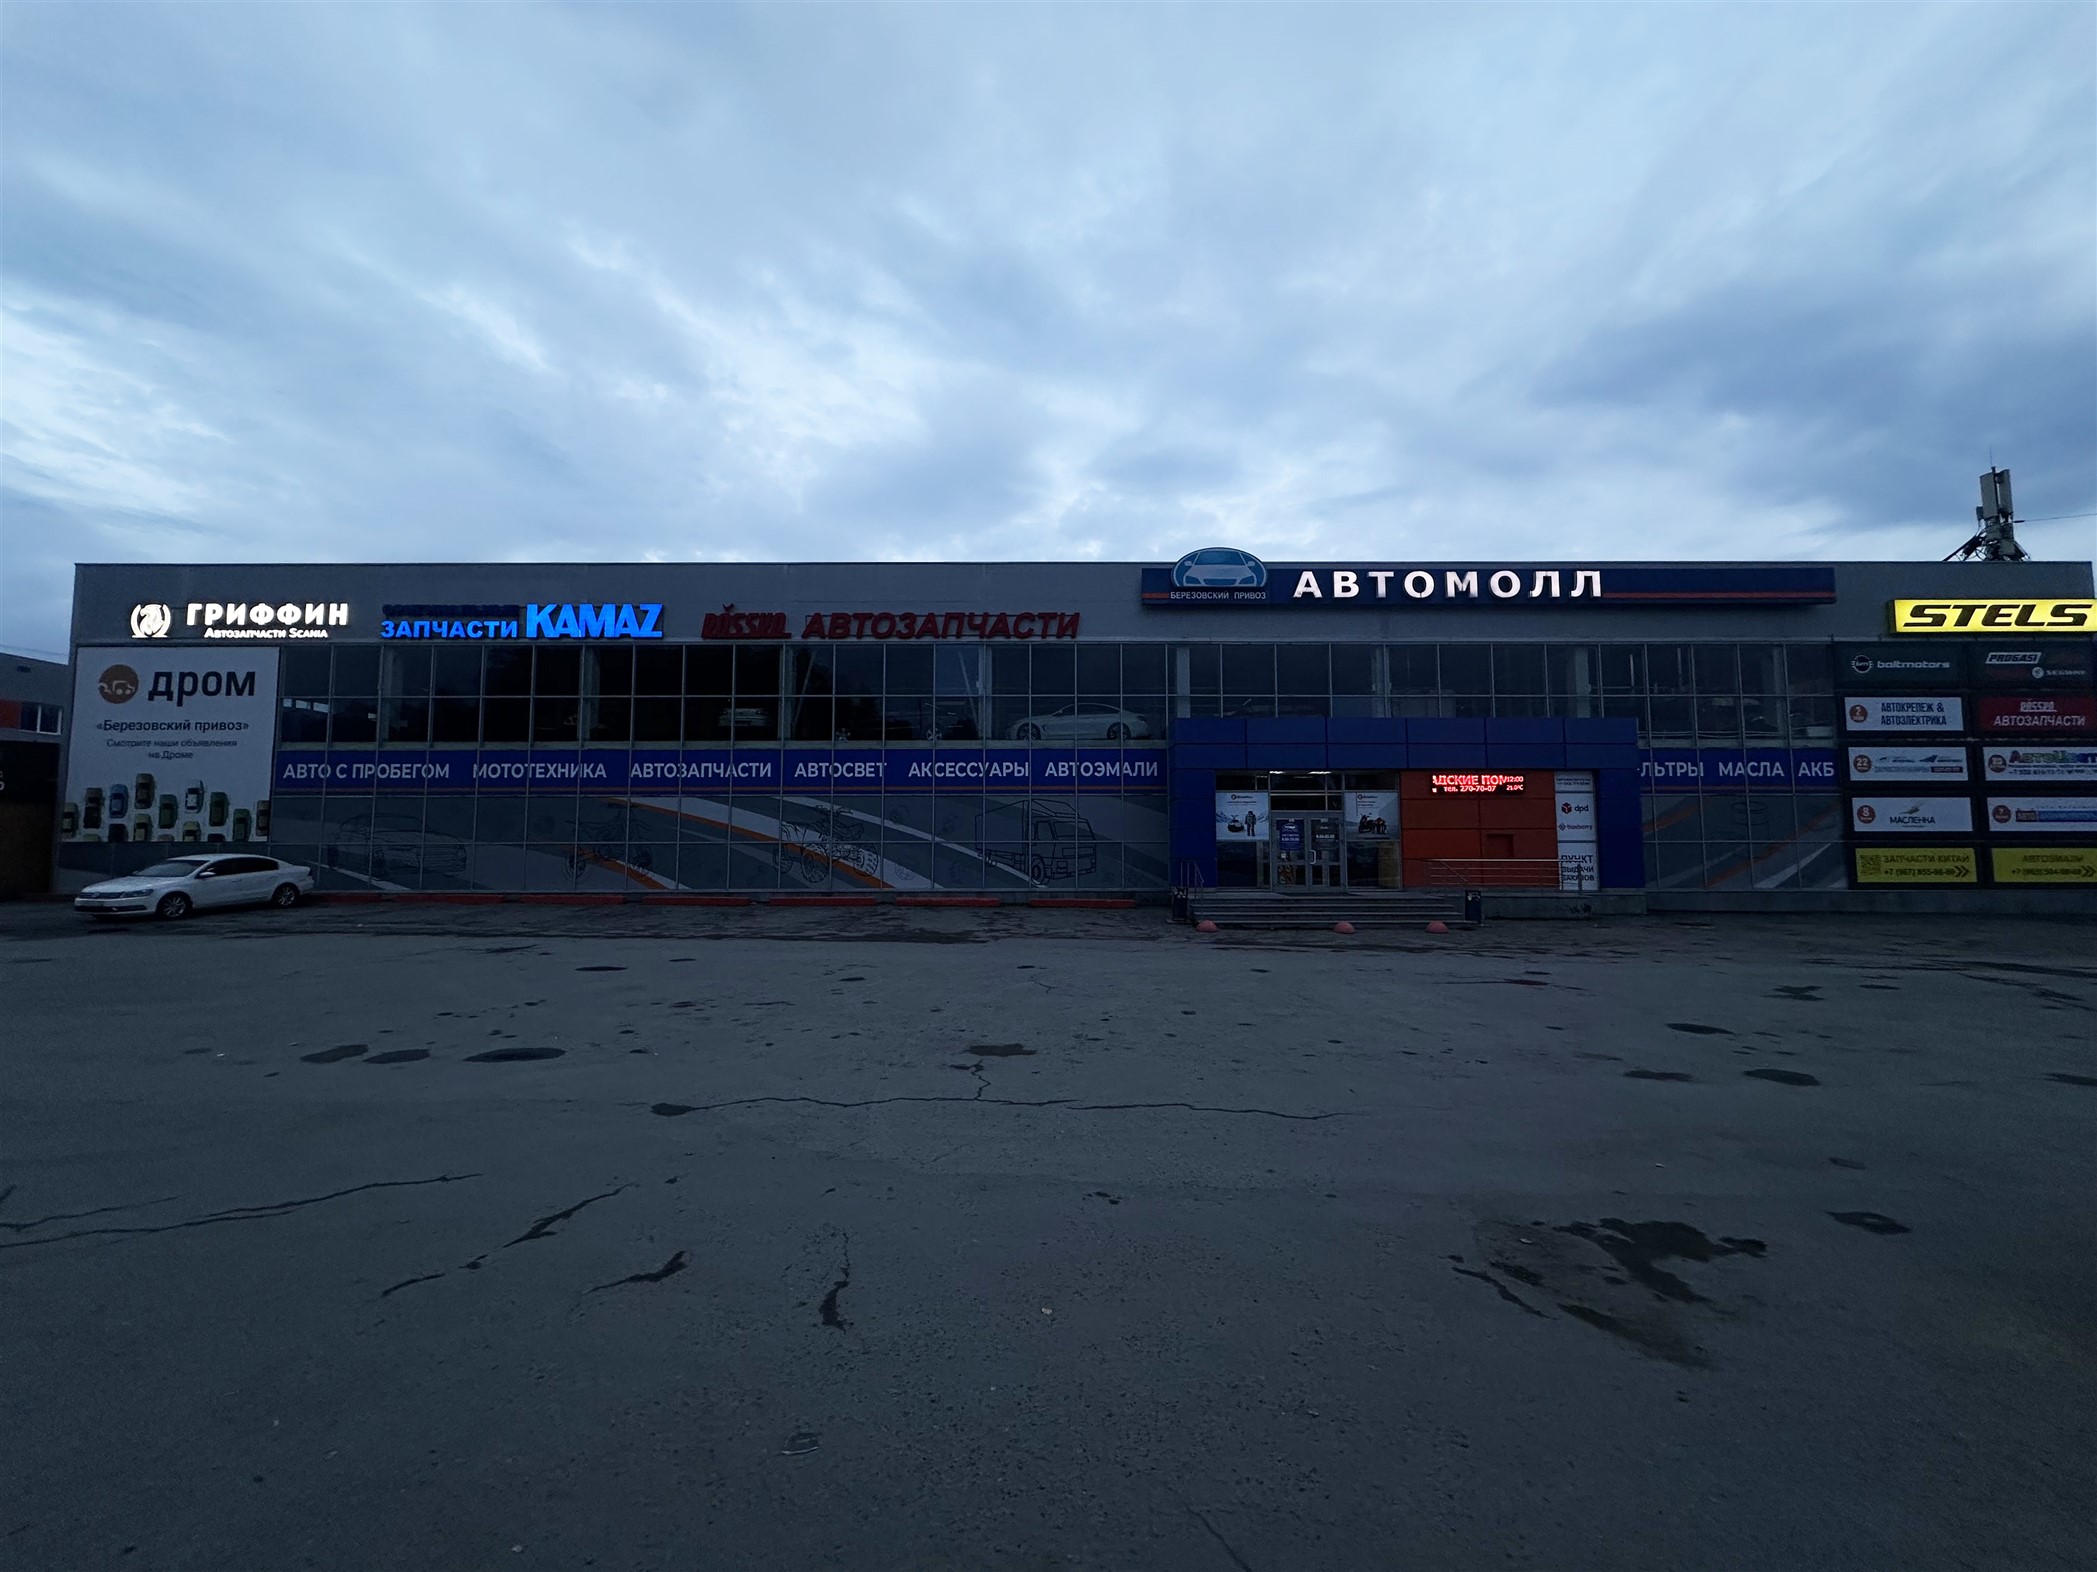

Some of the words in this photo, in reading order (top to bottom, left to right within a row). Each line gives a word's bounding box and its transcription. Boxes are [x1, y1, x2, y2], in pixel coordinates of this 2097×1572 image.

[1292, 570, 1602, 599] АВТОМОЛЛ
[1170, 591, 1230, 600] БЕРЕЗОВСКИЙ
[1233, 591, 1267, 600] ПРИВОЗ
[186, 602, 349, 626] ГРИФФИН
[525, 603, 664, 638] KAMAZ
[1903, 604, 2093, 627] STELS
[380, 620, 519, 639] ЗАПЧАСТИ
[801, 612, 1080, 639] АВТОЗАПЧАСТИ
[148, 671, 256, 706] дром
[1881, 702, 1934, 713] АВТОКРЕПЕЖ
[1936, 702, 1945, 713] &
[96, 719, 191, 733] «Березовский
[194, 723, 249, 733] привоз»
[1881, 715, 1947, 725] АВТОЭЛЕКТРИКА
[1993, 715, 2086, 727] АВТОЗАПЧАСТИ
[106, 739, 152, 749] Смотрите
[181, 738, 238, 748] объявления
[473, 763, 607, 778] МОТОТЕХНИКА
[630, 762, 772, 778] АВТОЗАПЧАСТИ
[794, 762, 887, 778] АВТОСВЕТ
[908, 761, 1029, 777] АКСЕССУАРЫ
[1044, 761, 1158, 777] АВТОЭМАЛИ
[1637, 761, 1704, 777] ЛЬТРЫ
[1718, 761, 1786, 777] МАСЛА
[1798, 761, 1835, 777] АКБ
[1857, 758, 1868, 767] 22
[283, 763, 331, 779] АВТО
[335, 763, 348, 779] С
[352, 763, 450, 779] ПРОБЕГОМ
[1574, 804, 1589, 814] dpd
[1883, 855, 1935, 863] ЗАПЧАСТИ
